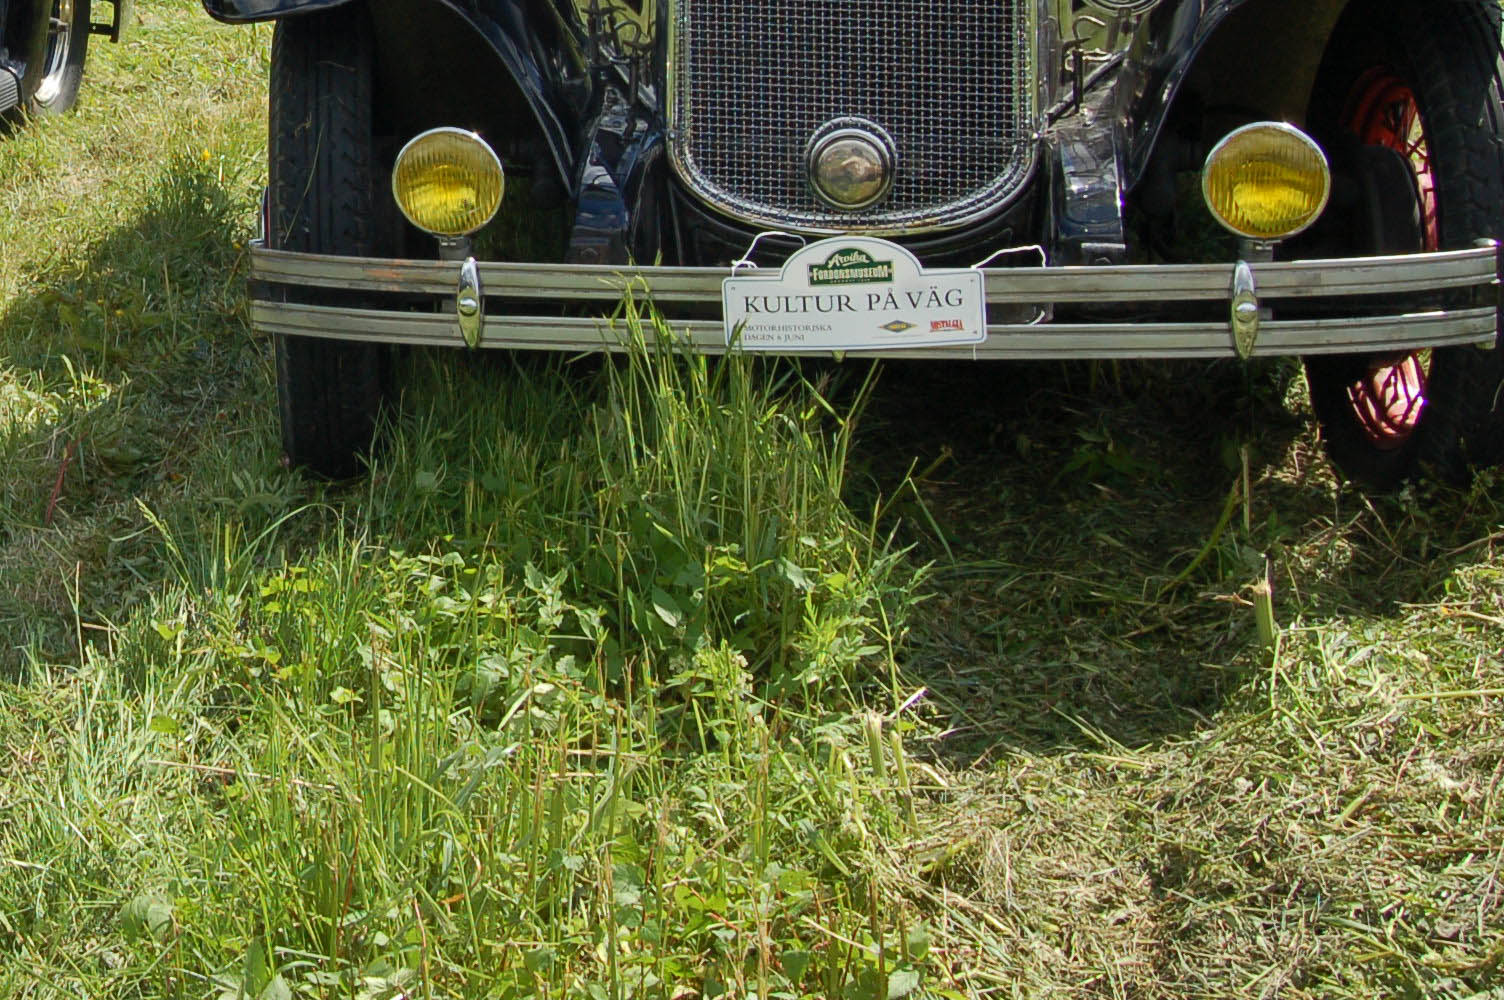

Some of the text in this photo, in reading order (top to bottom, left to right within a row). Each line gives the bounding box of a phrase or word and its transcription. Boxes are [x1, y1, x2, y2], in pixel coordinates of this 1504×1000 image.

[744, 286, 963, 314] KULTUR PÅ VÄG
